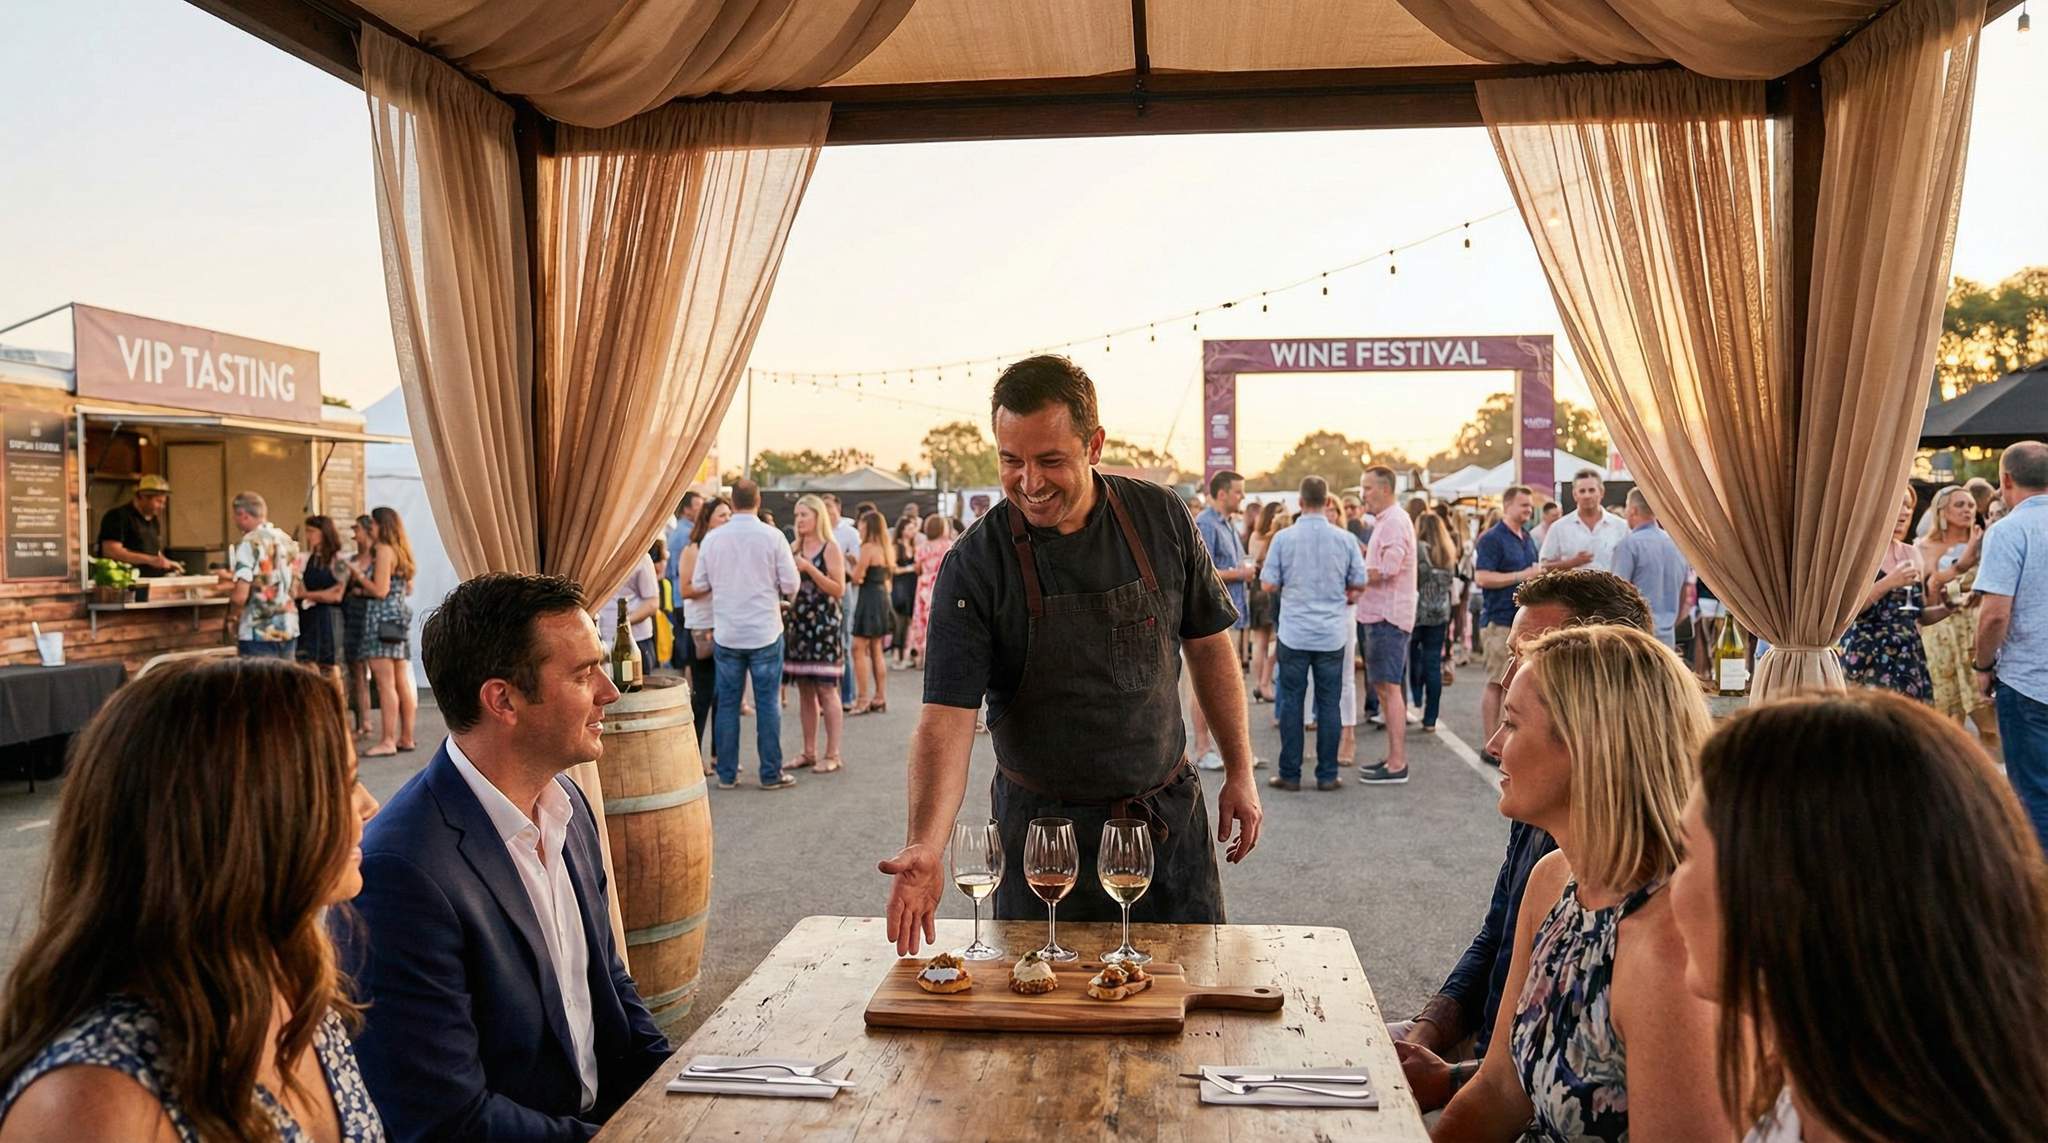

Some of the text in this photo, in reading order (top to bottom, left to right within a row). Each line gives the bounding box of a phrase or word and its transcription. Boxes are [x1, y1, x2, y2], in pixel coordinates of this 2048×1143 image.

[117, 335, 296, 402] VIP TASTING
[1270, 340, 1488, 368] WINE FESTIVAL
